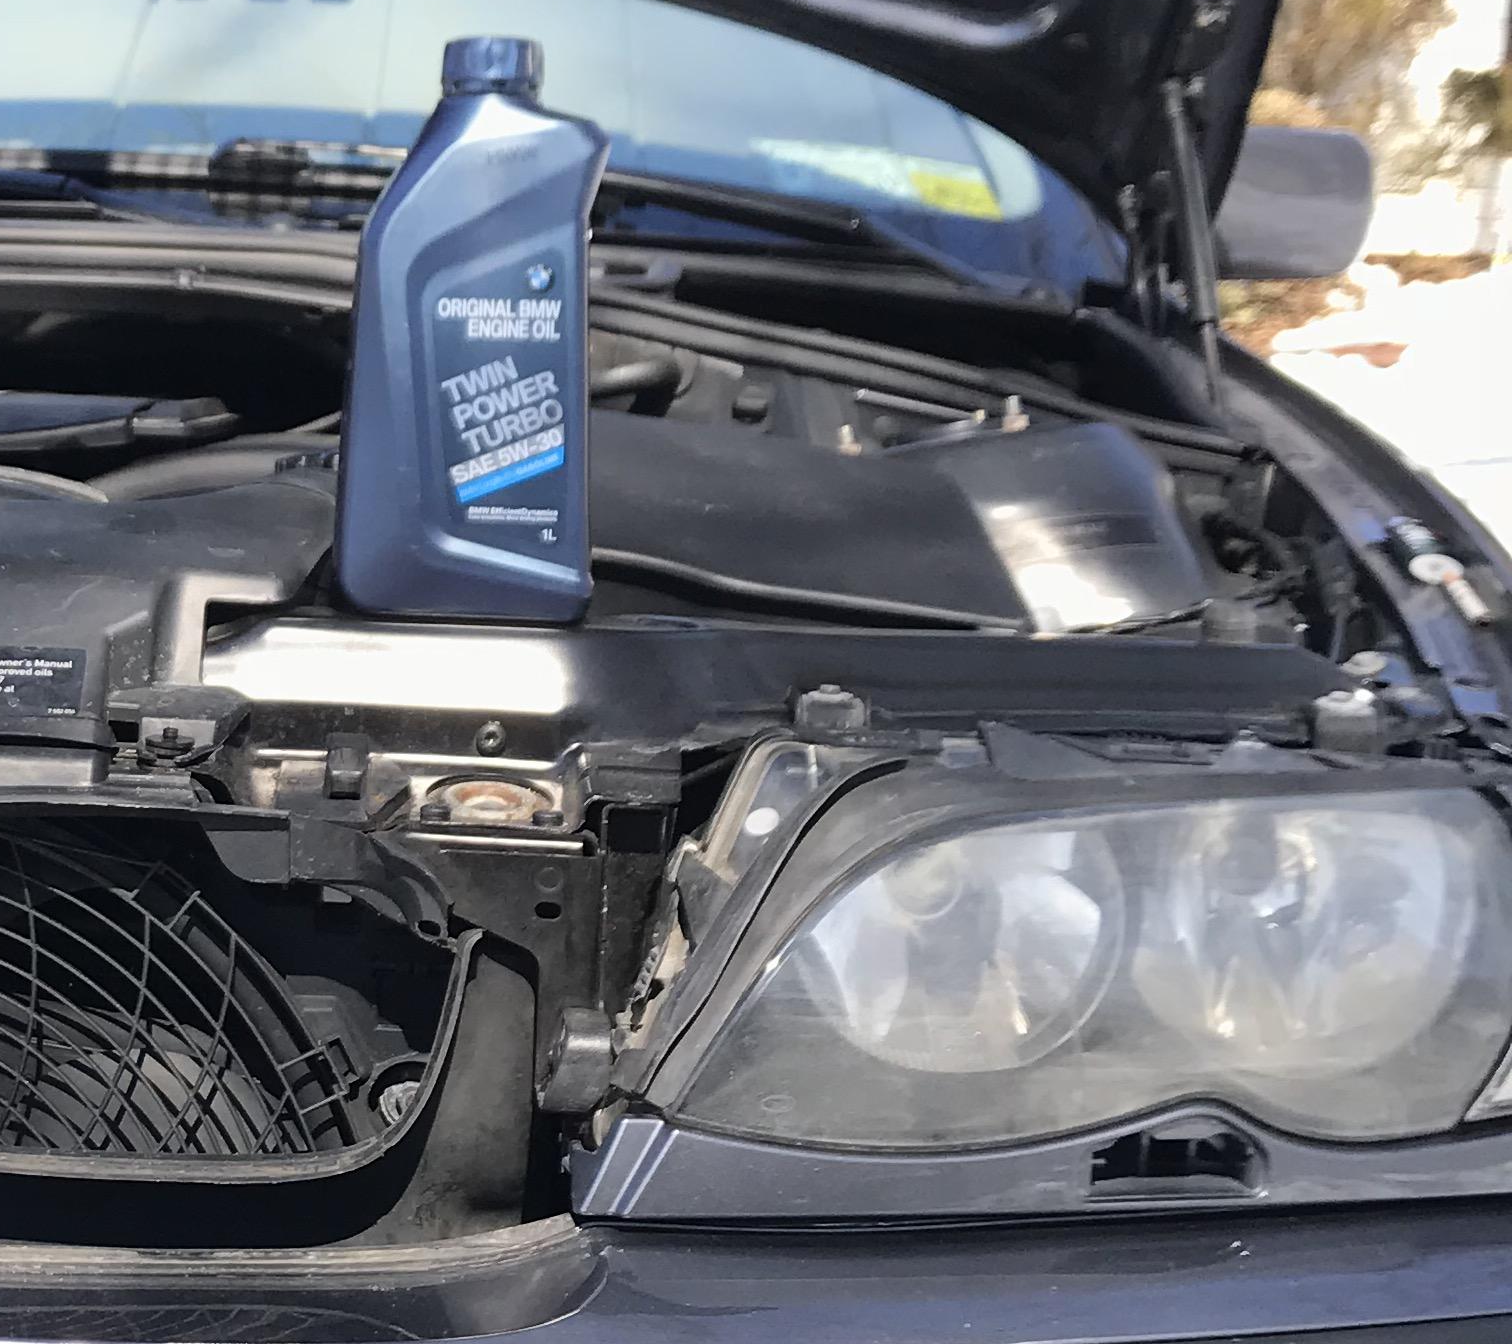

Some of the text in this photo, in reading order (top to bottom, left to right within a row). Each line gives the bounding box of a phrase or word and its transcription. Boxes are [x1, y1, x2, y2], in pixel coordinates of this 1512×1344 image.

[438, 297, 562, 319] ORIGINAL BMW
[468, 318, 561, 339] ENGINE OIL
[441, 355, 519, 402] TWIN
[453, 370, 559, 429] POWER
[461, 399, 563, 453] TURBO
[450, 450, 497, 485] SAE
[499, 428, 563, 468] 5W-30
[541, 528, 557, 541] 1L
[34, 659, 73, 669] Manual
[34, 668, 53, 677] oils
[3, 685, 15, 693] at
